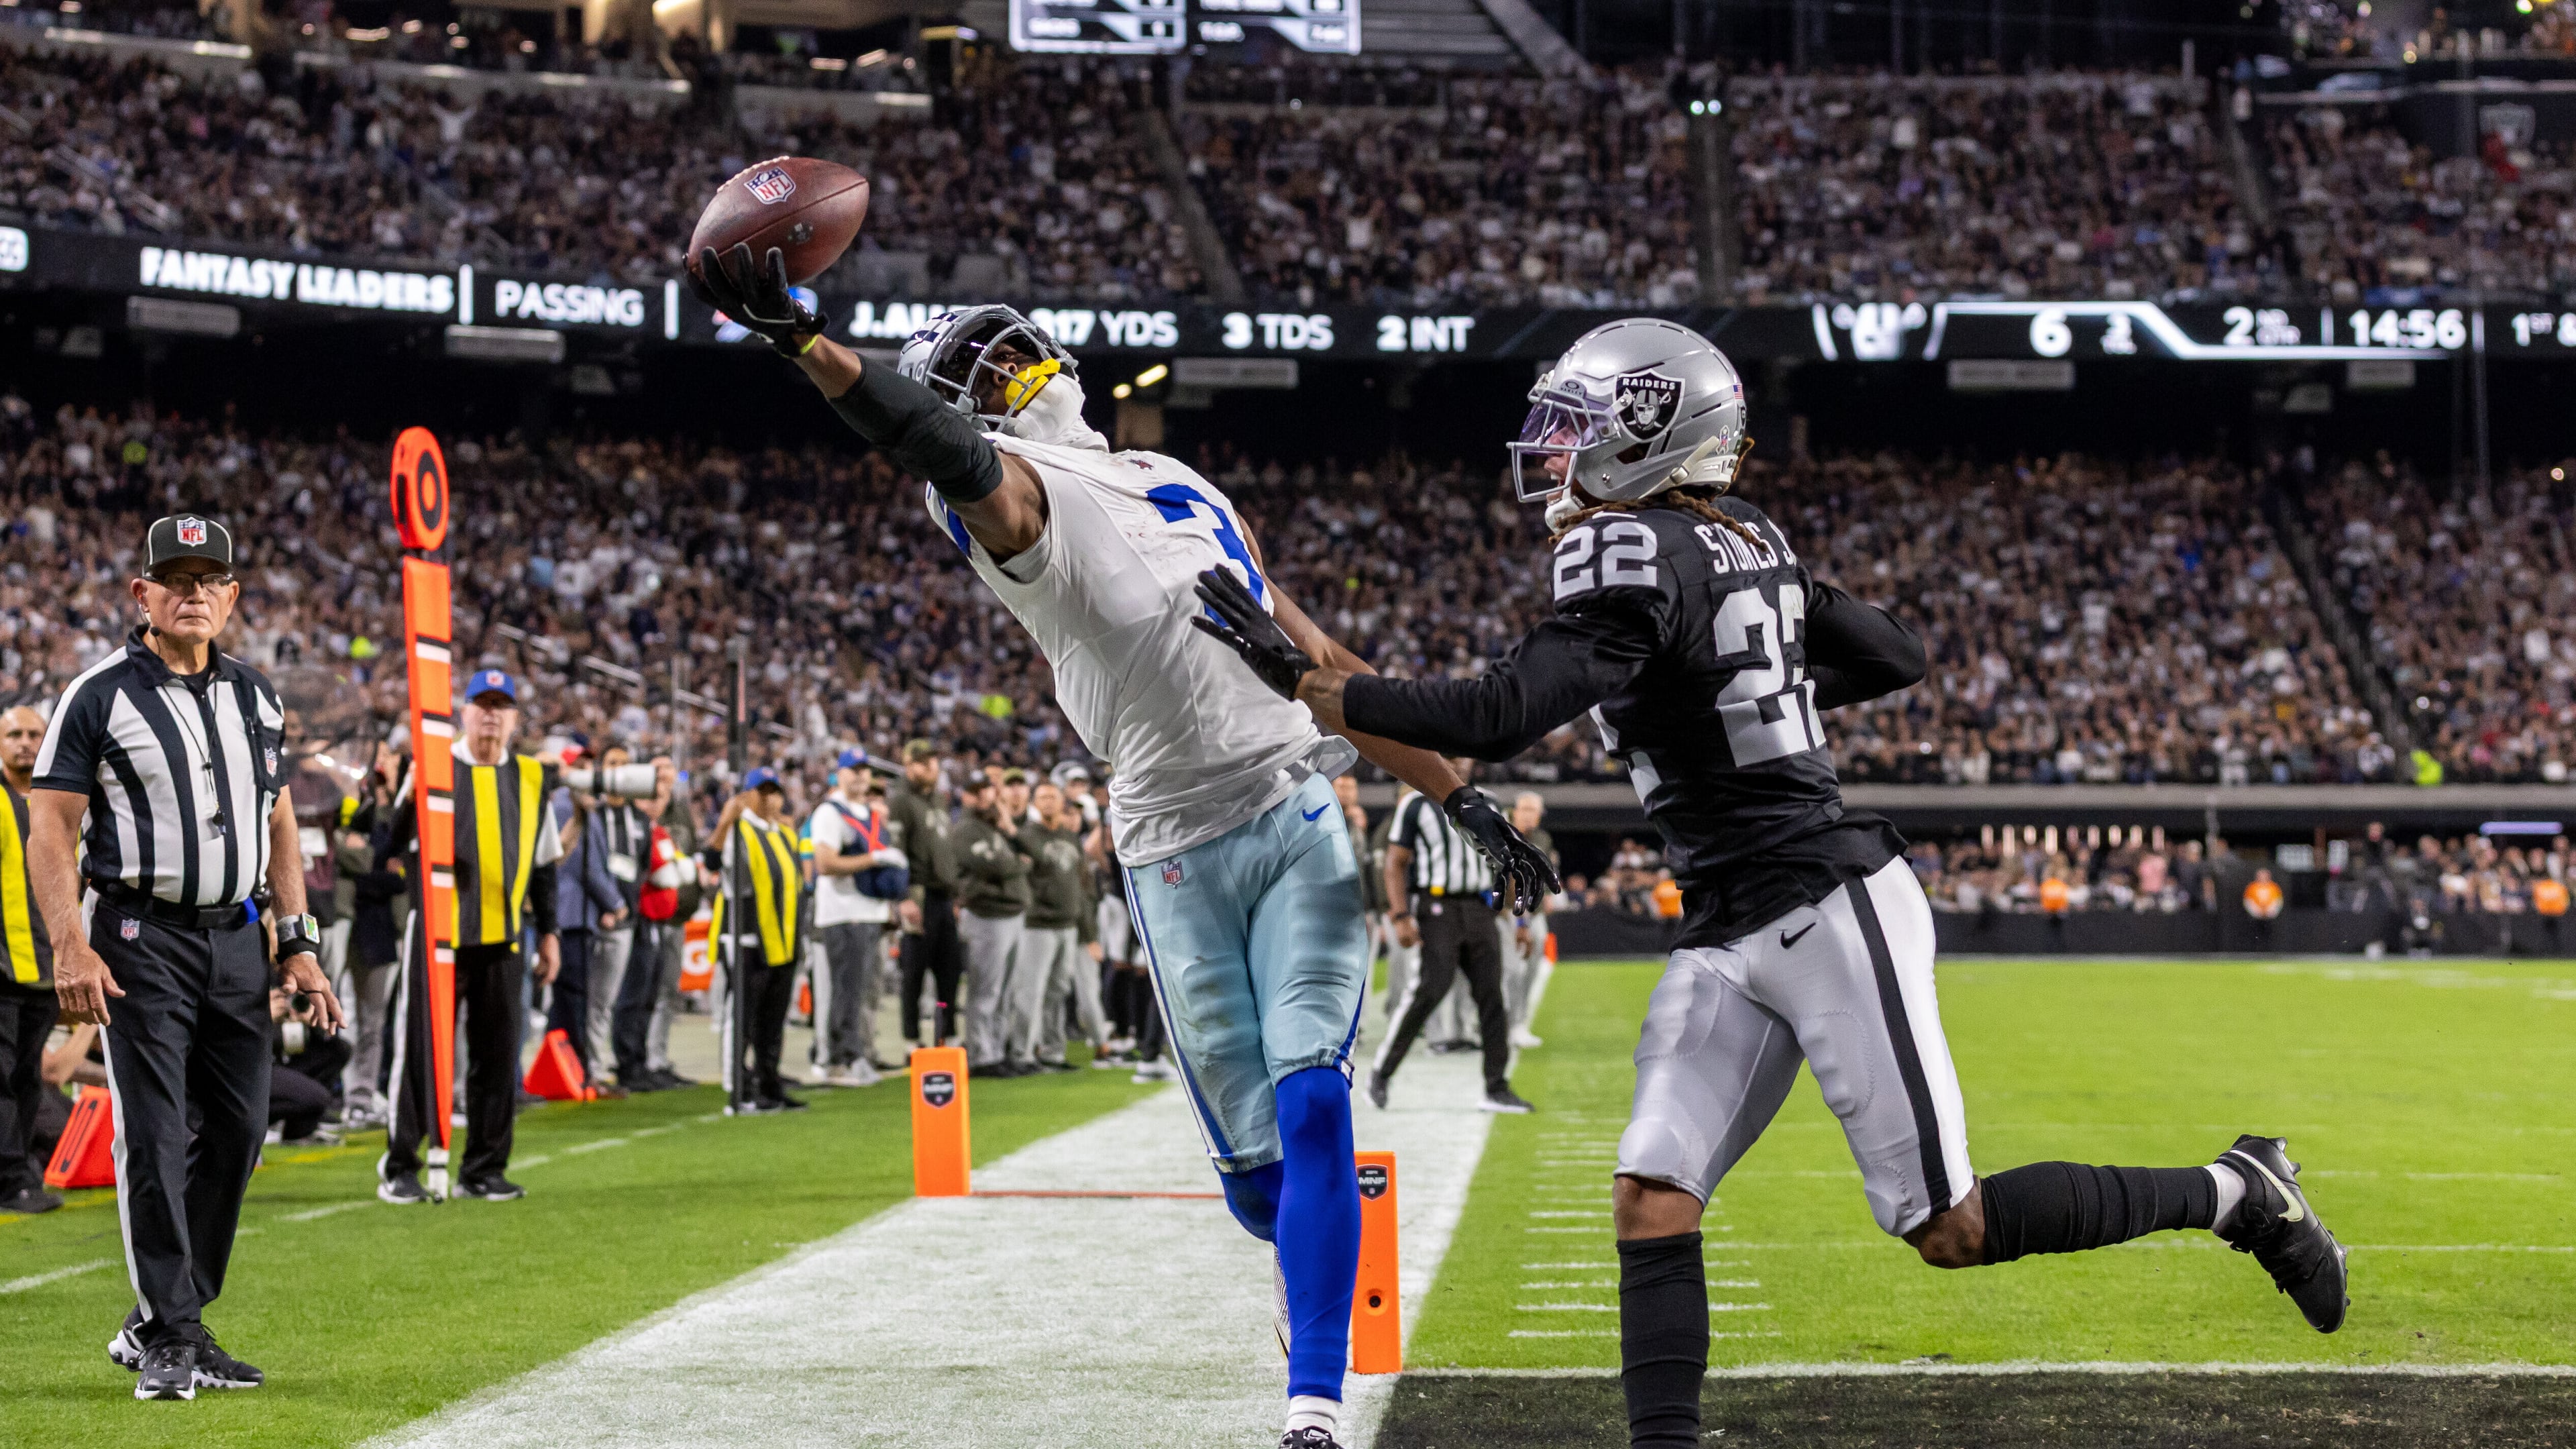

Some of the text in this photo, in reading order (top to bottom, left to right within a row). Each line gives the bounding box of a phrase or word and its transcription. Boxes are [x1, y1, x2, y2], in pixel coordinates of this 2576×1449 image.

[757, 177, 792, 199] NFL
[140, 246, 454, 314] FANTASY LEADERS
[495, 280, 644, 326] PASSING
[1099, 310, 1179, 347] YDS
[1222, 312, 1253, 350] 3
[1256, 313, 1334, 350] TDS
[1377, 315, 1407, 352] 2
[1410, 316, 1475, 352] INT
[2029, 309, 2072, 358] 6
[2349, 309, 2467, 350] 14:56
[1622, 378, 1676, 390] RAIDERS
[182, 529, 203, 541] NFL
[1145, 483, 1264, 628] 3
[1553, 521, 1657, 601] 22
[1358, 1177, 1386, 1185] MNF
